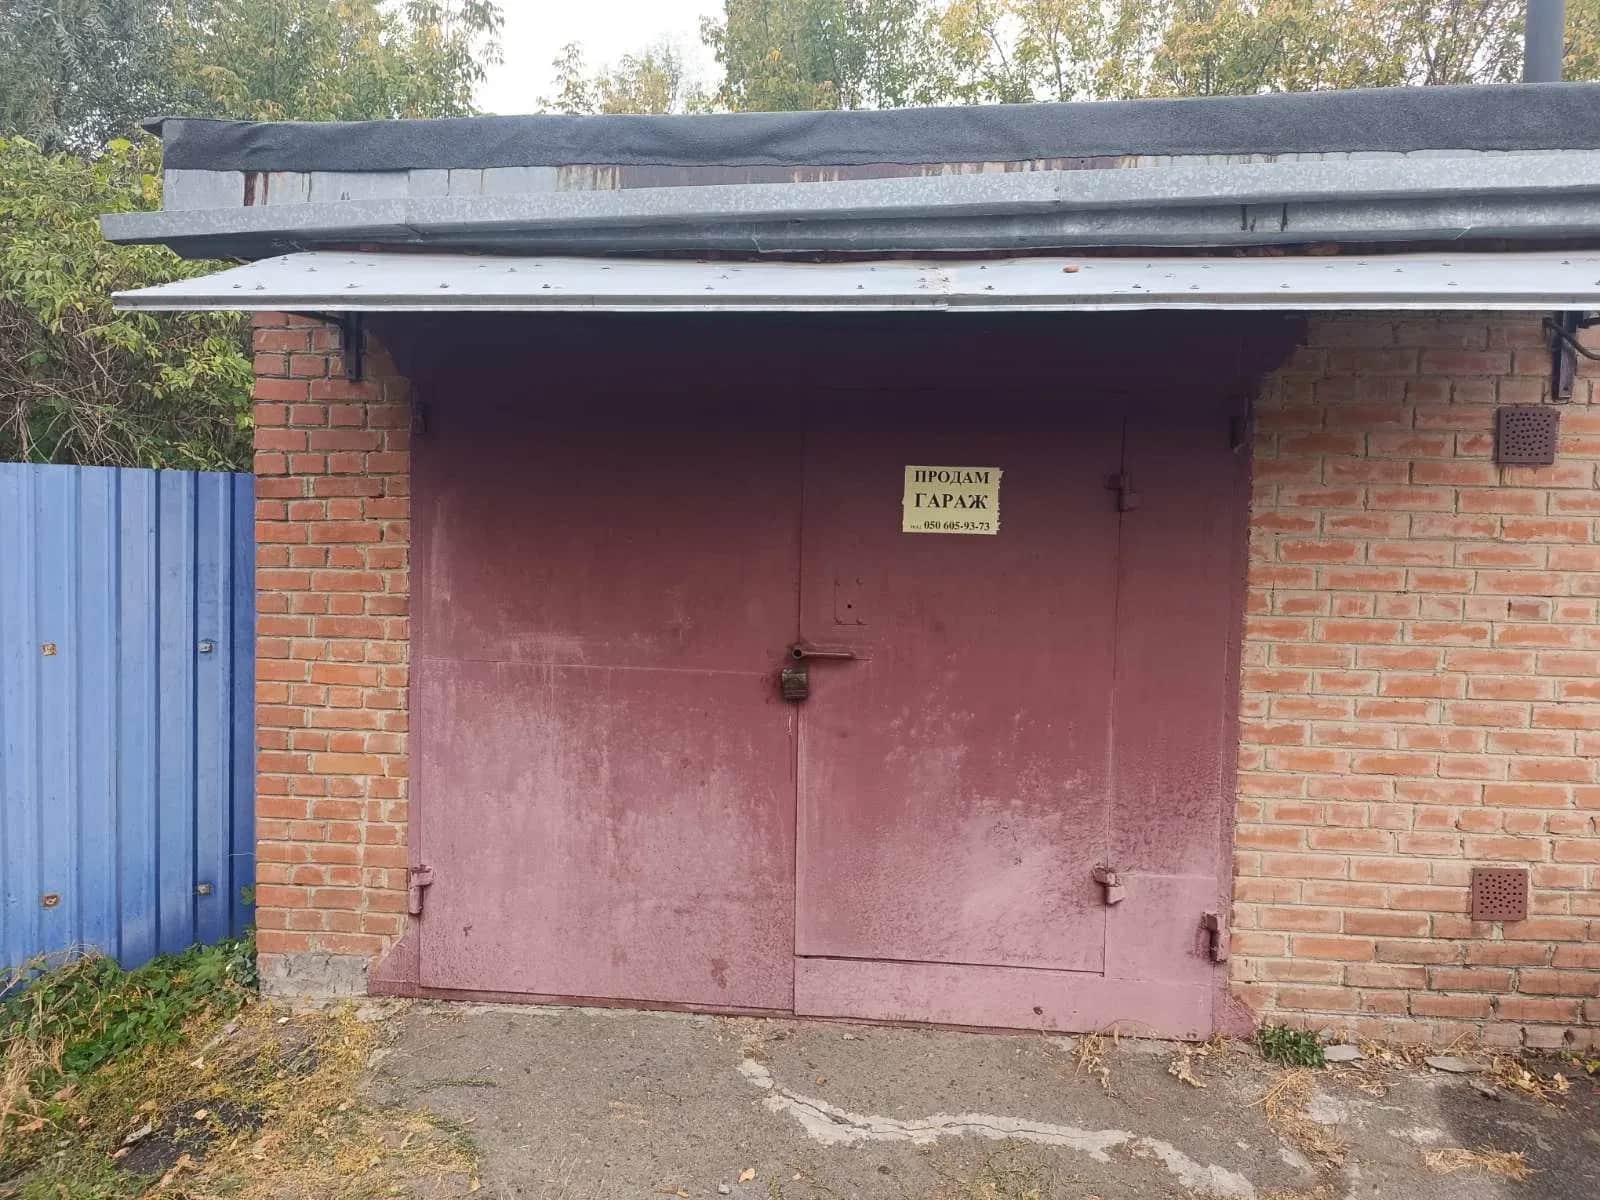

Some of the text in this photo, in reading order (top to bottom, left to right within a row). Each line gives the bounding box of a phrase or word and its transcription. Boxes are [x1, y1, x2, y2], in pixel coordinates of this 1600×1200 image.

[914, 470, 990, 485] ПРОДАМ
[915, 493, 988, 509] ГАРАЖ
[924, 521, 941, 530] 050
[943, 521, 990, 531] 605-93-73
